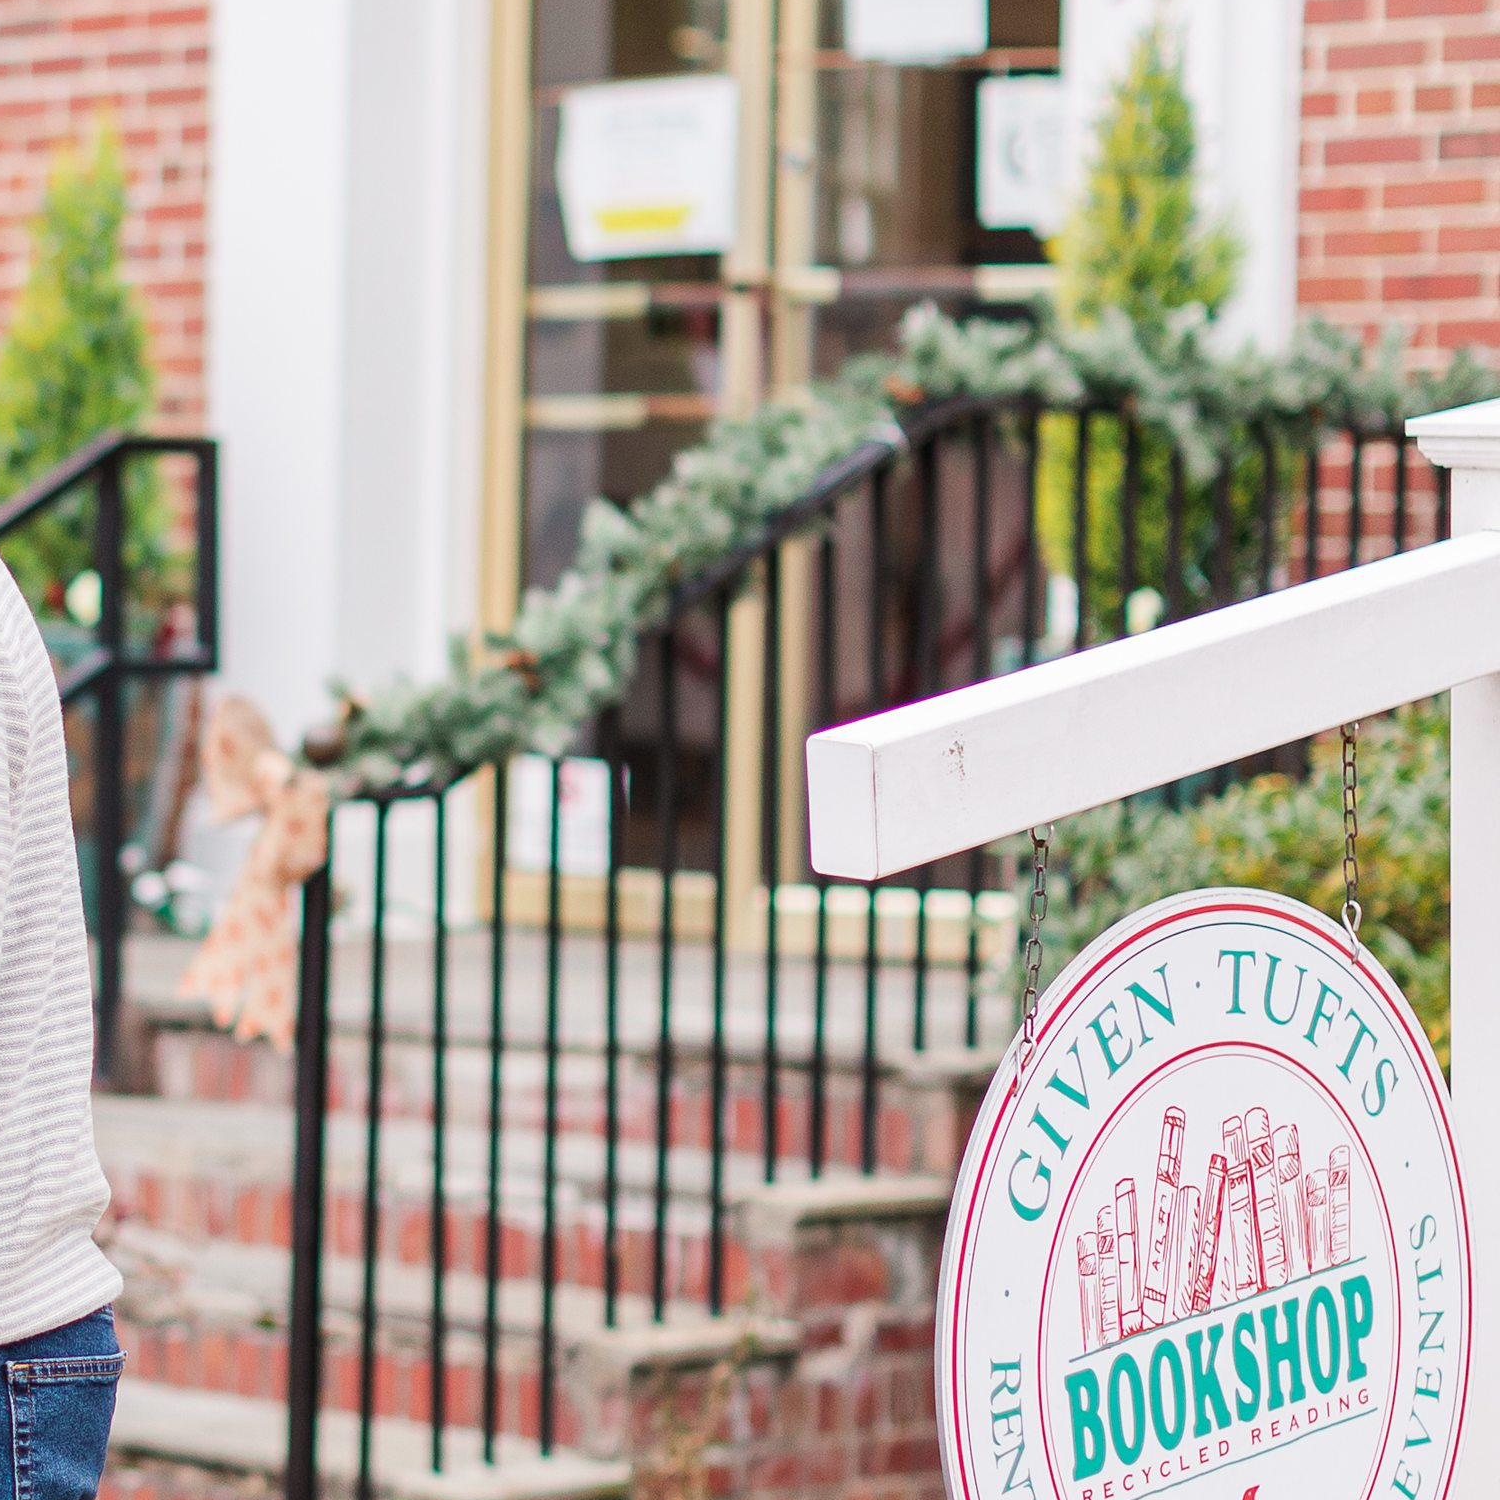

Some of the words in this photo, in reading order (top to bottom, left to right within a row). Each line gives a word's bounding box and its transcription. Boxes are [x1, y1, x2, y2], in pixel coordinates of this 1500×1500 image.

[1007, 961, 1181, 1224] GIVEN
[1216, 948, 1400, 1120] TUFTS
[1063, 1274, 1375, 1483] BOOKSHOP
[1249, 1388, 1374, 1445] READING
